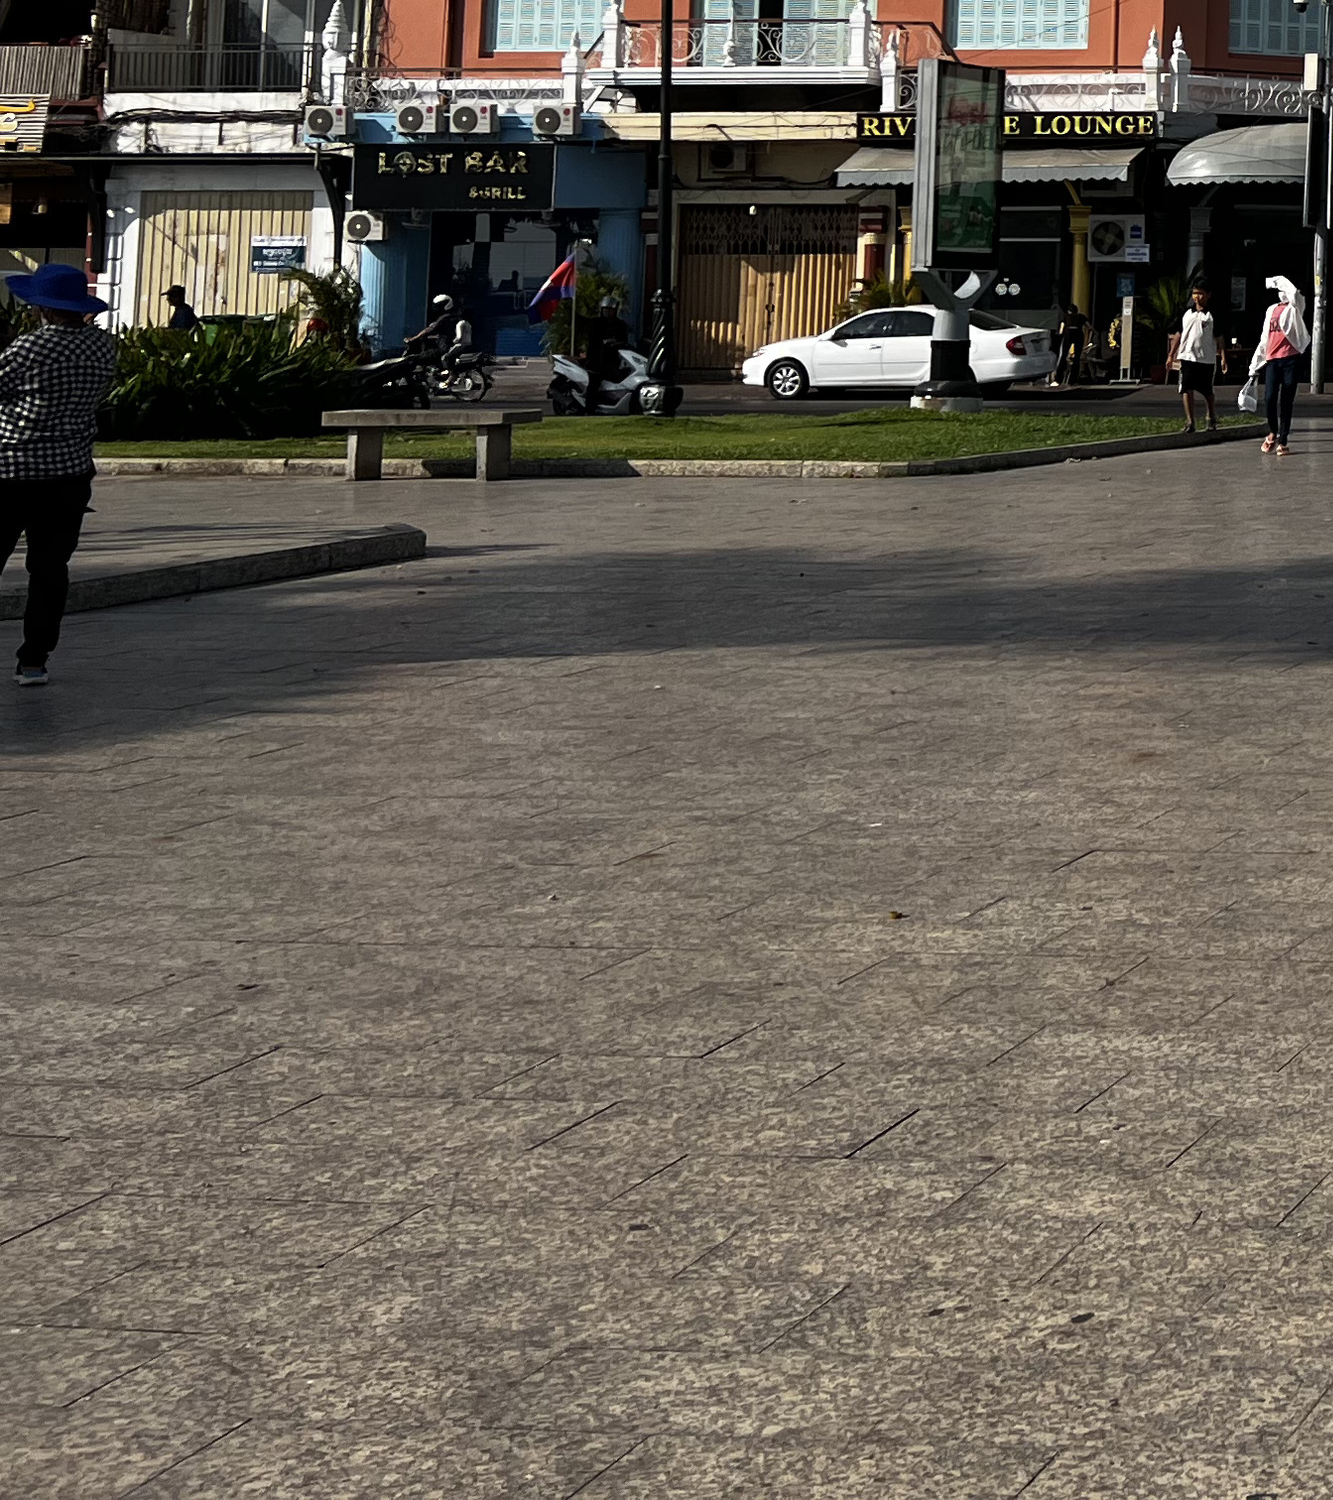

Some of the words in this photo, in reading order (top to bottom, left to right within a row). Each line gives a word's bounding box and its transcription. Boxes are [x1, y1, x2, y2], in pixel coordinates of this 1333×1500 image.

[1034, 115, 1154, 135] LOUNGE
[378, 151, 453, 176] LOST
[464, 151, 528, 174] BAR
